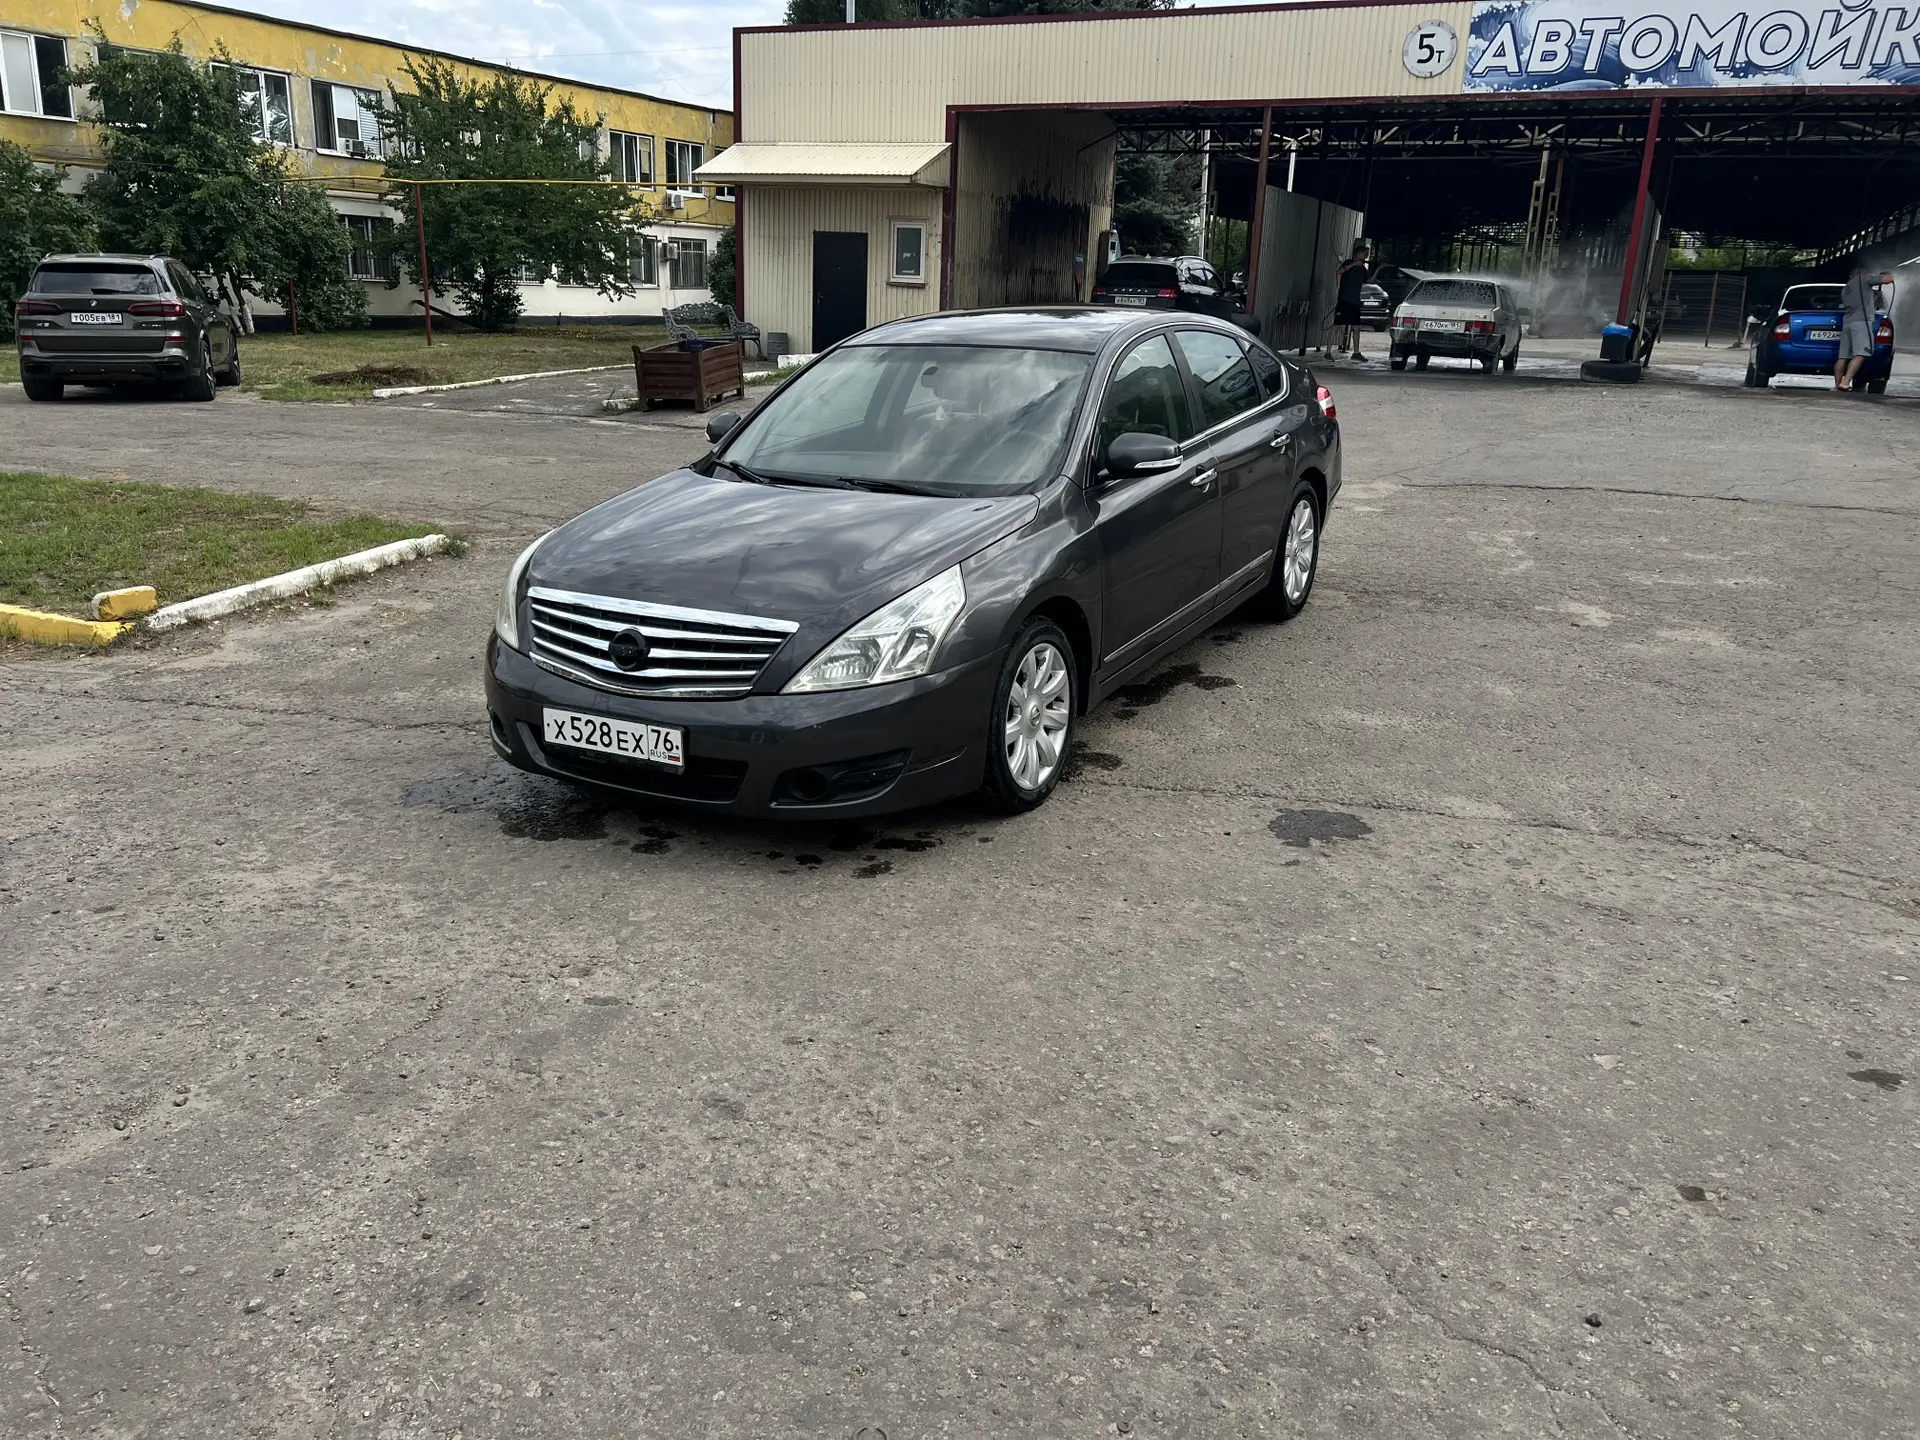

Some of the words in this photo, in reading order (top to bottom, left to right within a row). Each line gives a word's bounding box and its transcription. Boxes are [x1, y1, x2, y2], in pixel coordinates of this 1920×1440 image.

[553, 716, 645, 755] Х528ЕХ
[650, 729, 674, 752] 76
[650, 749, 667, 760] RUS
